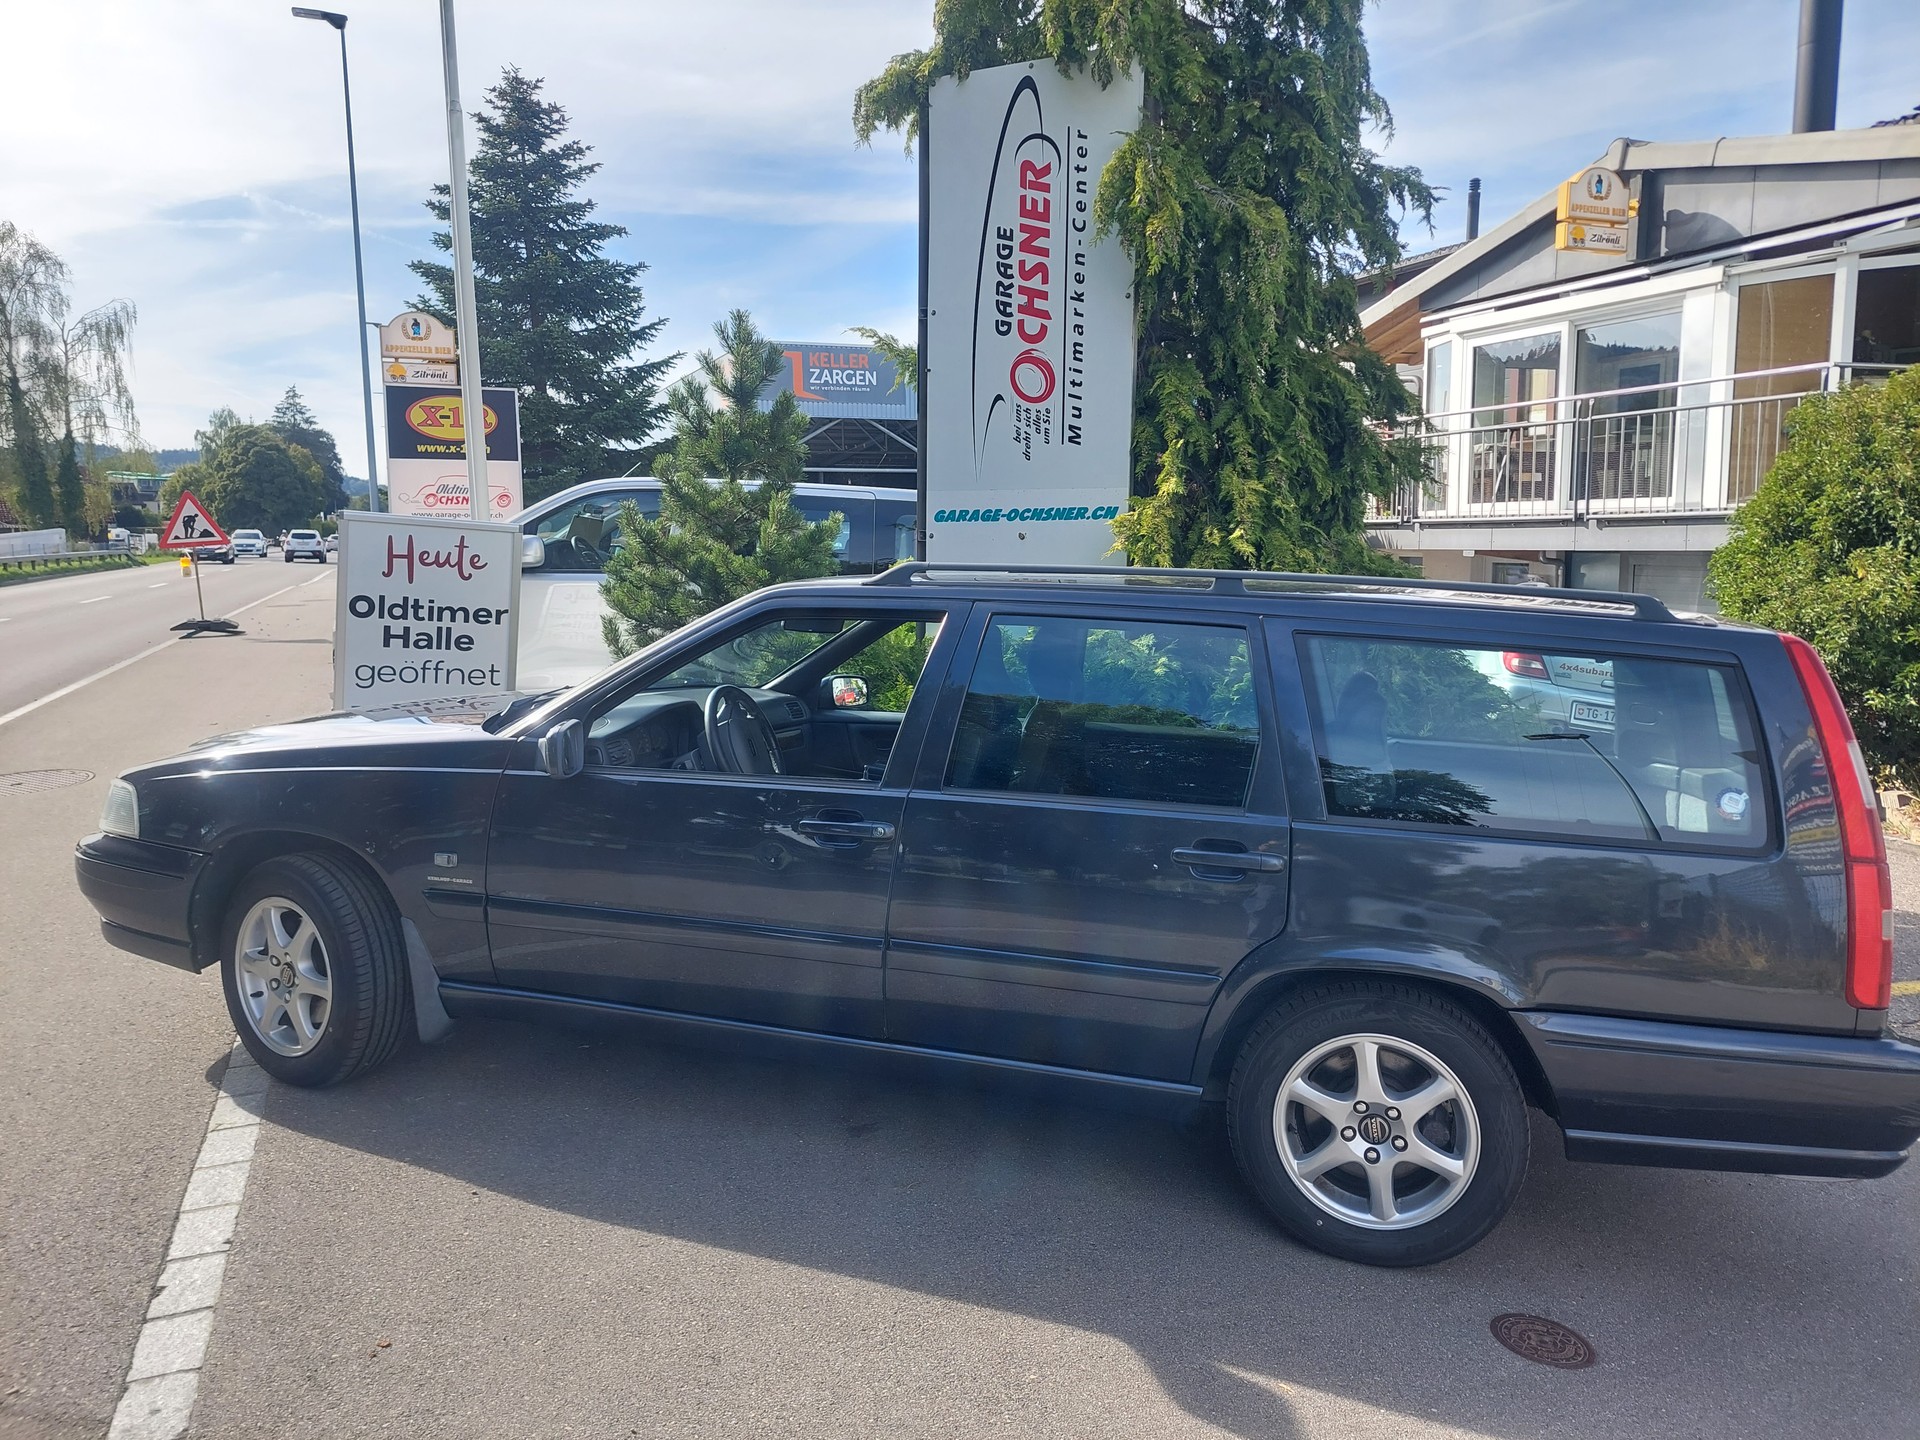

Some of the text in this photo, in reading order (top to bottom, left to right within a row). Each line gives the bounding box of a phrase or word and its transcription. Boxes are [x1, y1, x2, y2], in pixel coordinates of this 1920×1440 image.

[995, 226, 1014, 336] GARAGE
[1067, 129, 1088, 446] Multimarken-Center
[809, 352, 869, 368] KELLER
[809, 368, 877, 386] ZARGEN
[1013, 424, 1022, 444] bei
[1022, 407, 1031, 461] dreht sich
[1032, 408, 1041, 434] alles
[1042, 407, 1051, 444] um Sie
[424, 493, 470, 507] OCHSN
[934, 506, 1119, 523] GARAGE-OCHSNER.CH
[382, 534, 488, 584] Heute
[348, 595, 509, 625] Oldtimer
[382, 625, 475, 652] Halle
[355, 660, 501, 688] geöffnet
[1370, 1117, 1379, 1143] VOLVO
